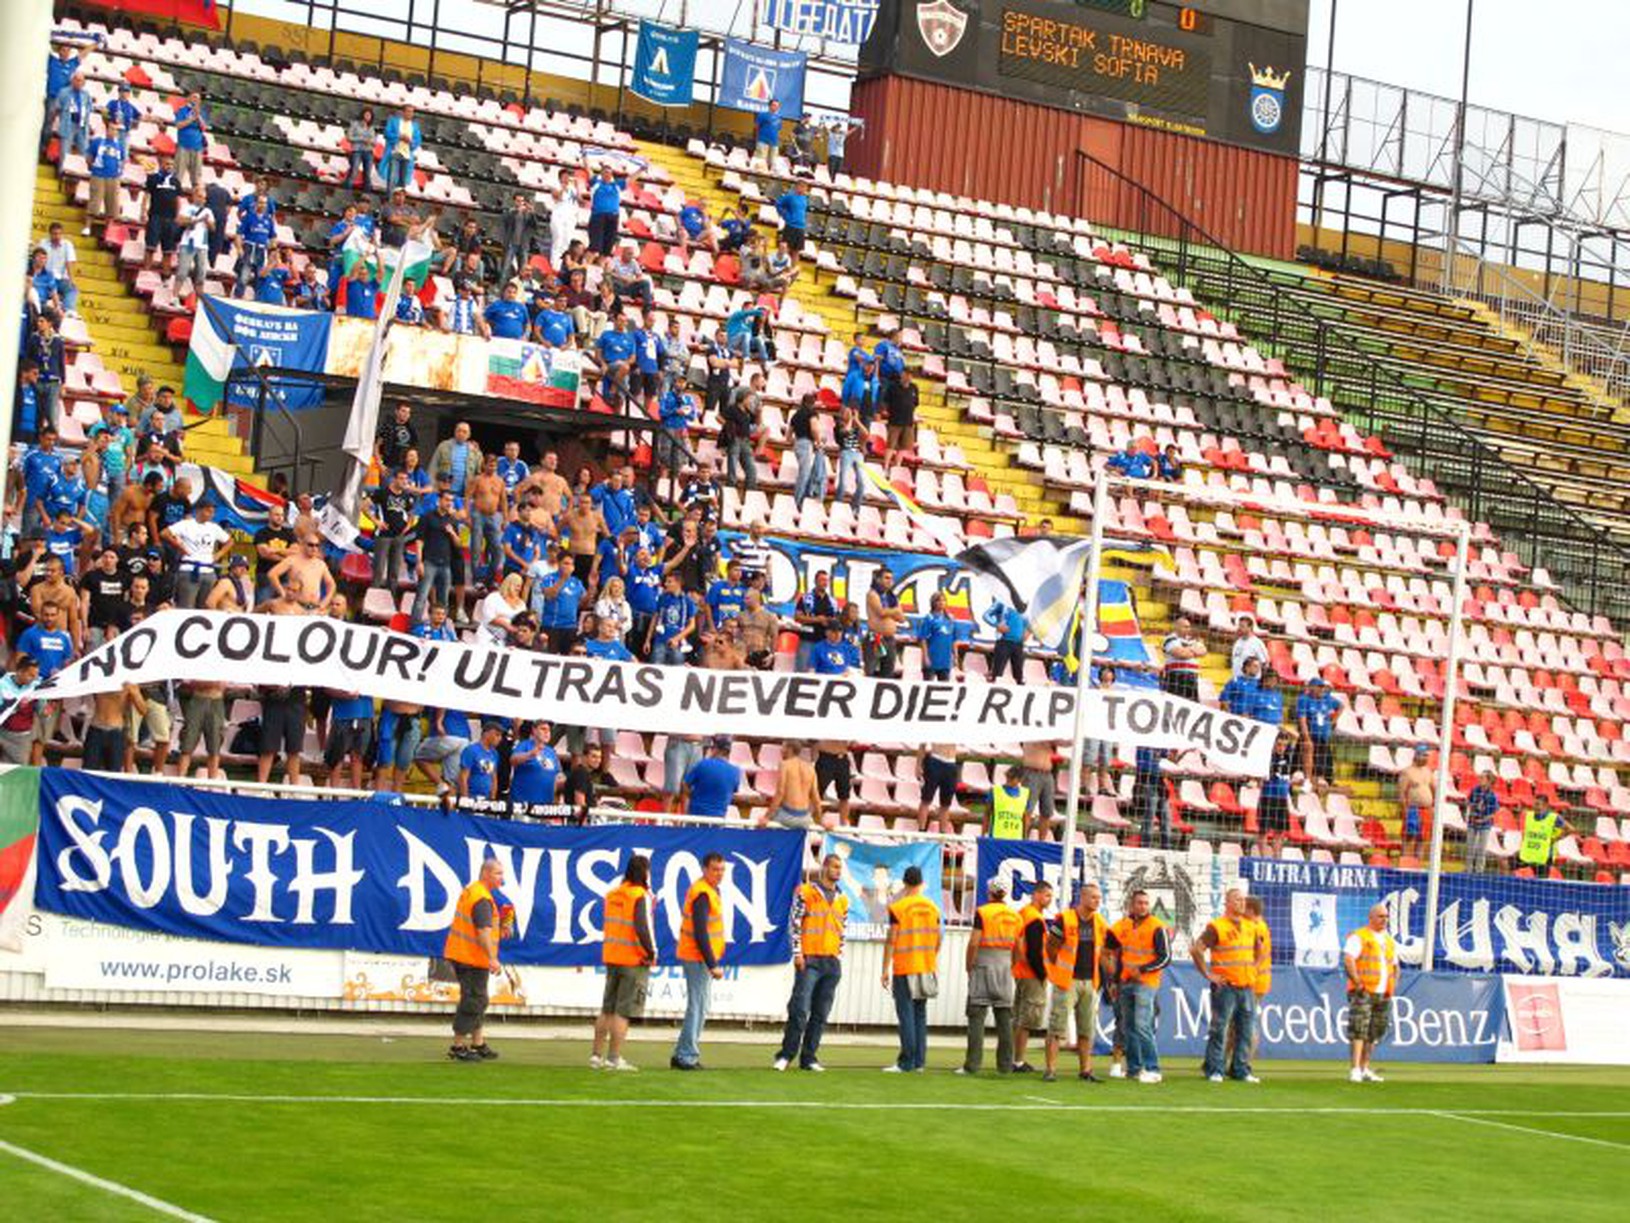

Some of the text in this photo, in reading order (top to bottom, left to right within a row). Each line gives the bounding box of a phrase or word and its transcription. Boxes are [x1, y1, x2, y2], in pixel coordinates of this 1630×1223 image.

[1001, 32, 1159, 85] LEVSKI SOFIA
[1003, 11, 1097, 50] SPARTAK
[1109, 34, 1185, 70] TRNAVA
[79, 628, 157, 682] NO
[174, 615, 438, 681] COLOUR!
[454, 650, 663, 709] ULTRAS
[681, 670, 856, 719] NEVER
[869, 683, 964, 723] DIE!
[1103, 695, 1261, 758] TOMAS!
[56, 795, 779, 944] SOUTH DVISON
[1252, 861, 1379, 889] ULTRA VARNA
[100, 958, 292, 985] www.prolake.sk
[1172, 987, 1498, 1048] McedeBenz
